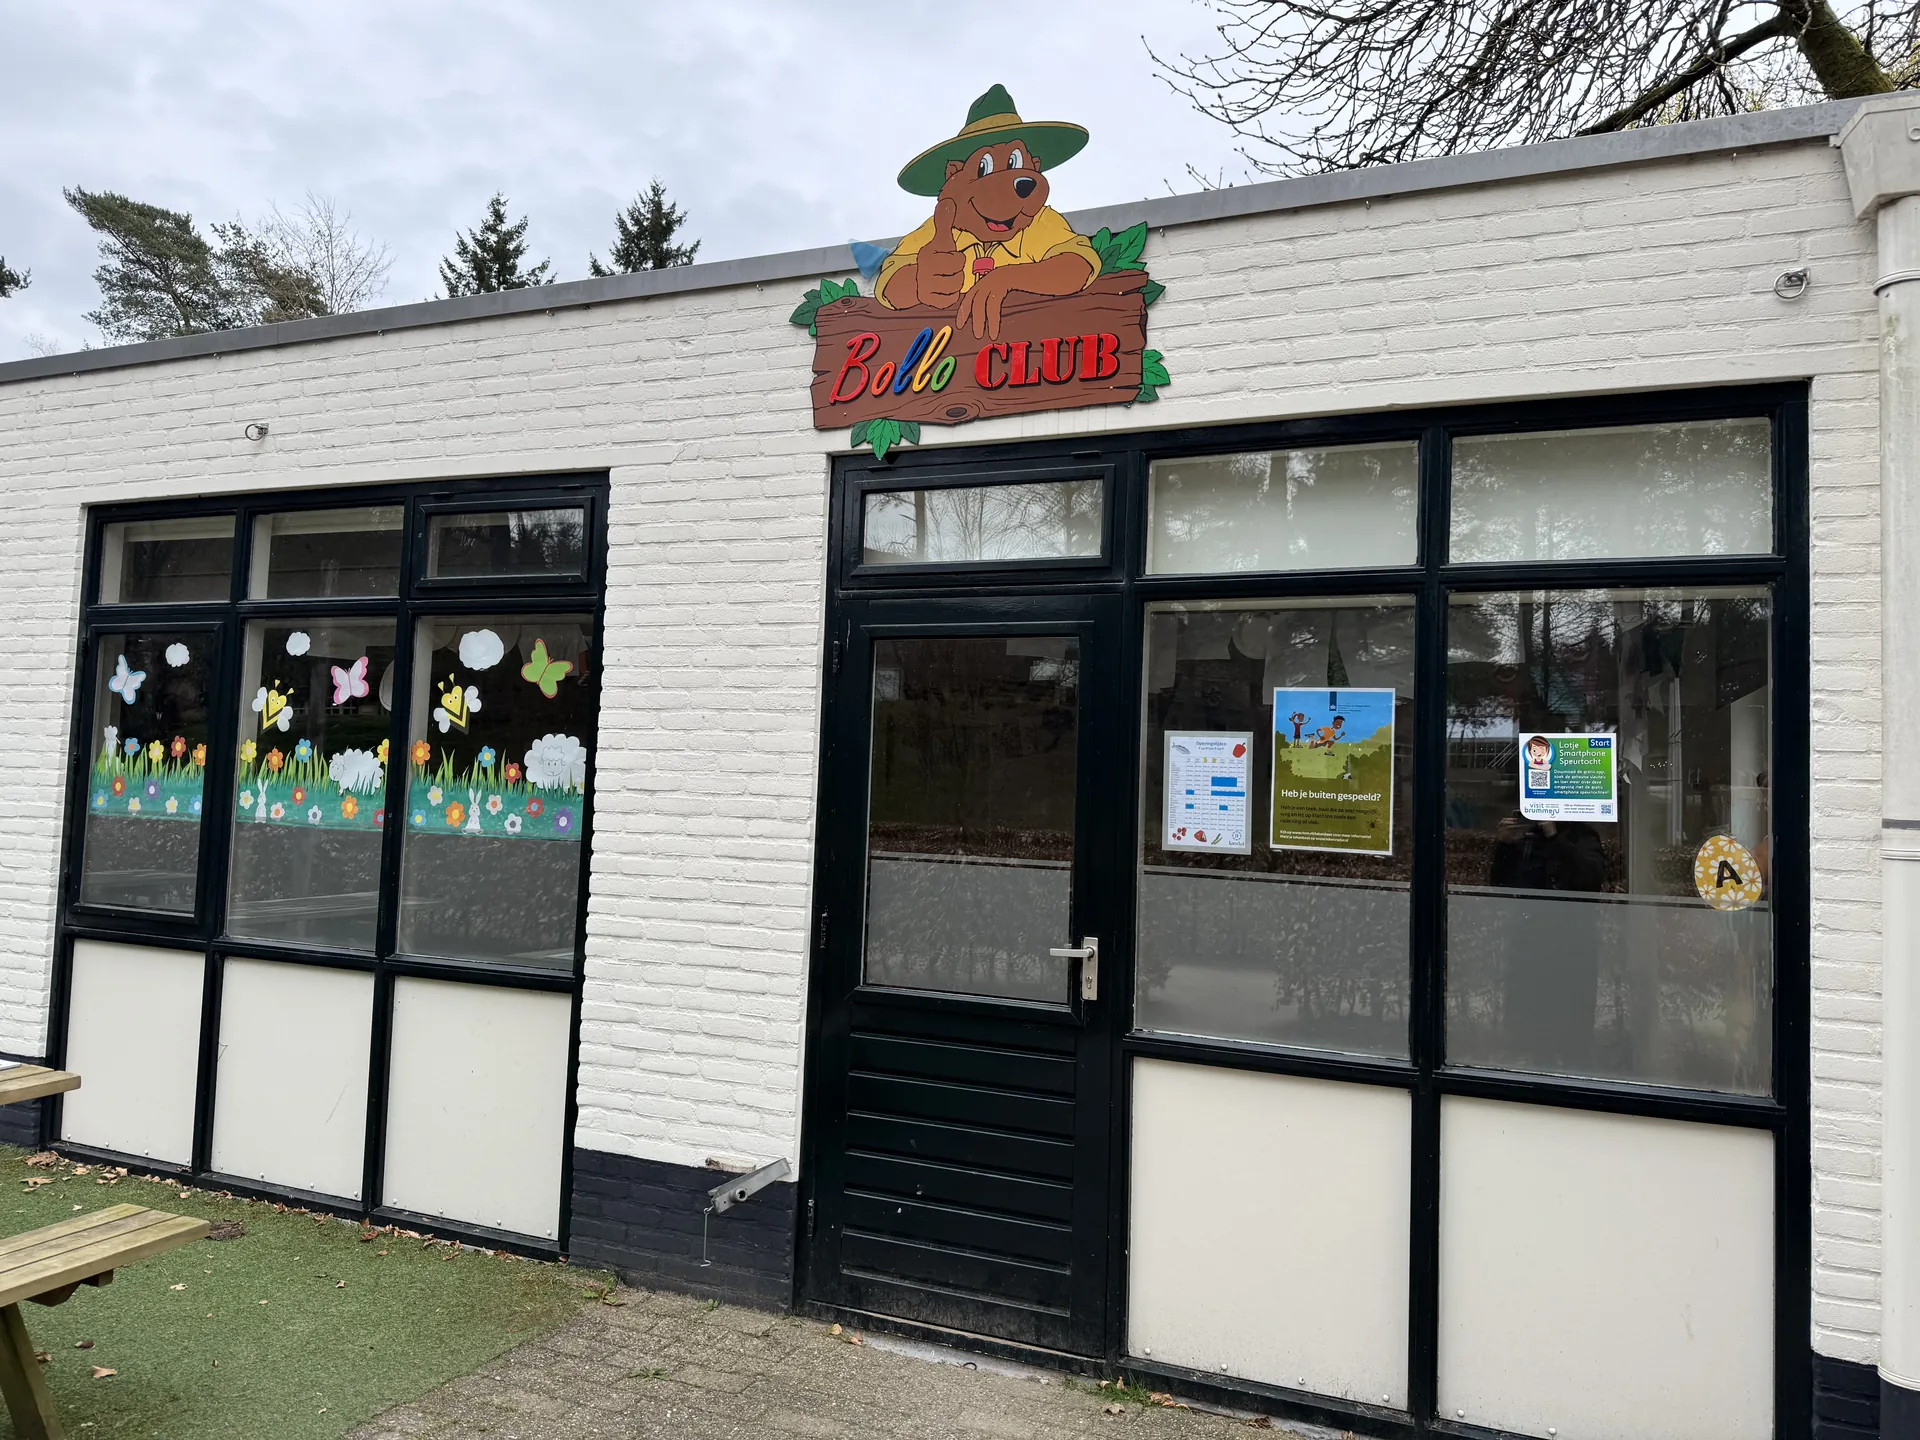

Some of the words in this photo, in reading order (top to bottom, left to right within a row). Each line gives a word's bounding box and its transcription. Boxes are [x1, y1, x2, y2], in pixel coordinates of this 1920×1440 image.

[829, 325, 956, 404] Bollo
[974, 332, 1120, 389] CLUB
[1559, 742, 1579, 750] Lotje
[1559, 750, 1606, 759] Smartphone
[1300, 790, 1307, 799] je
[1309, 790, 1336, 799] buiten
[1338, 793, 1381, 802] gespeeld?
[1716, 860, 1743, 888] A
